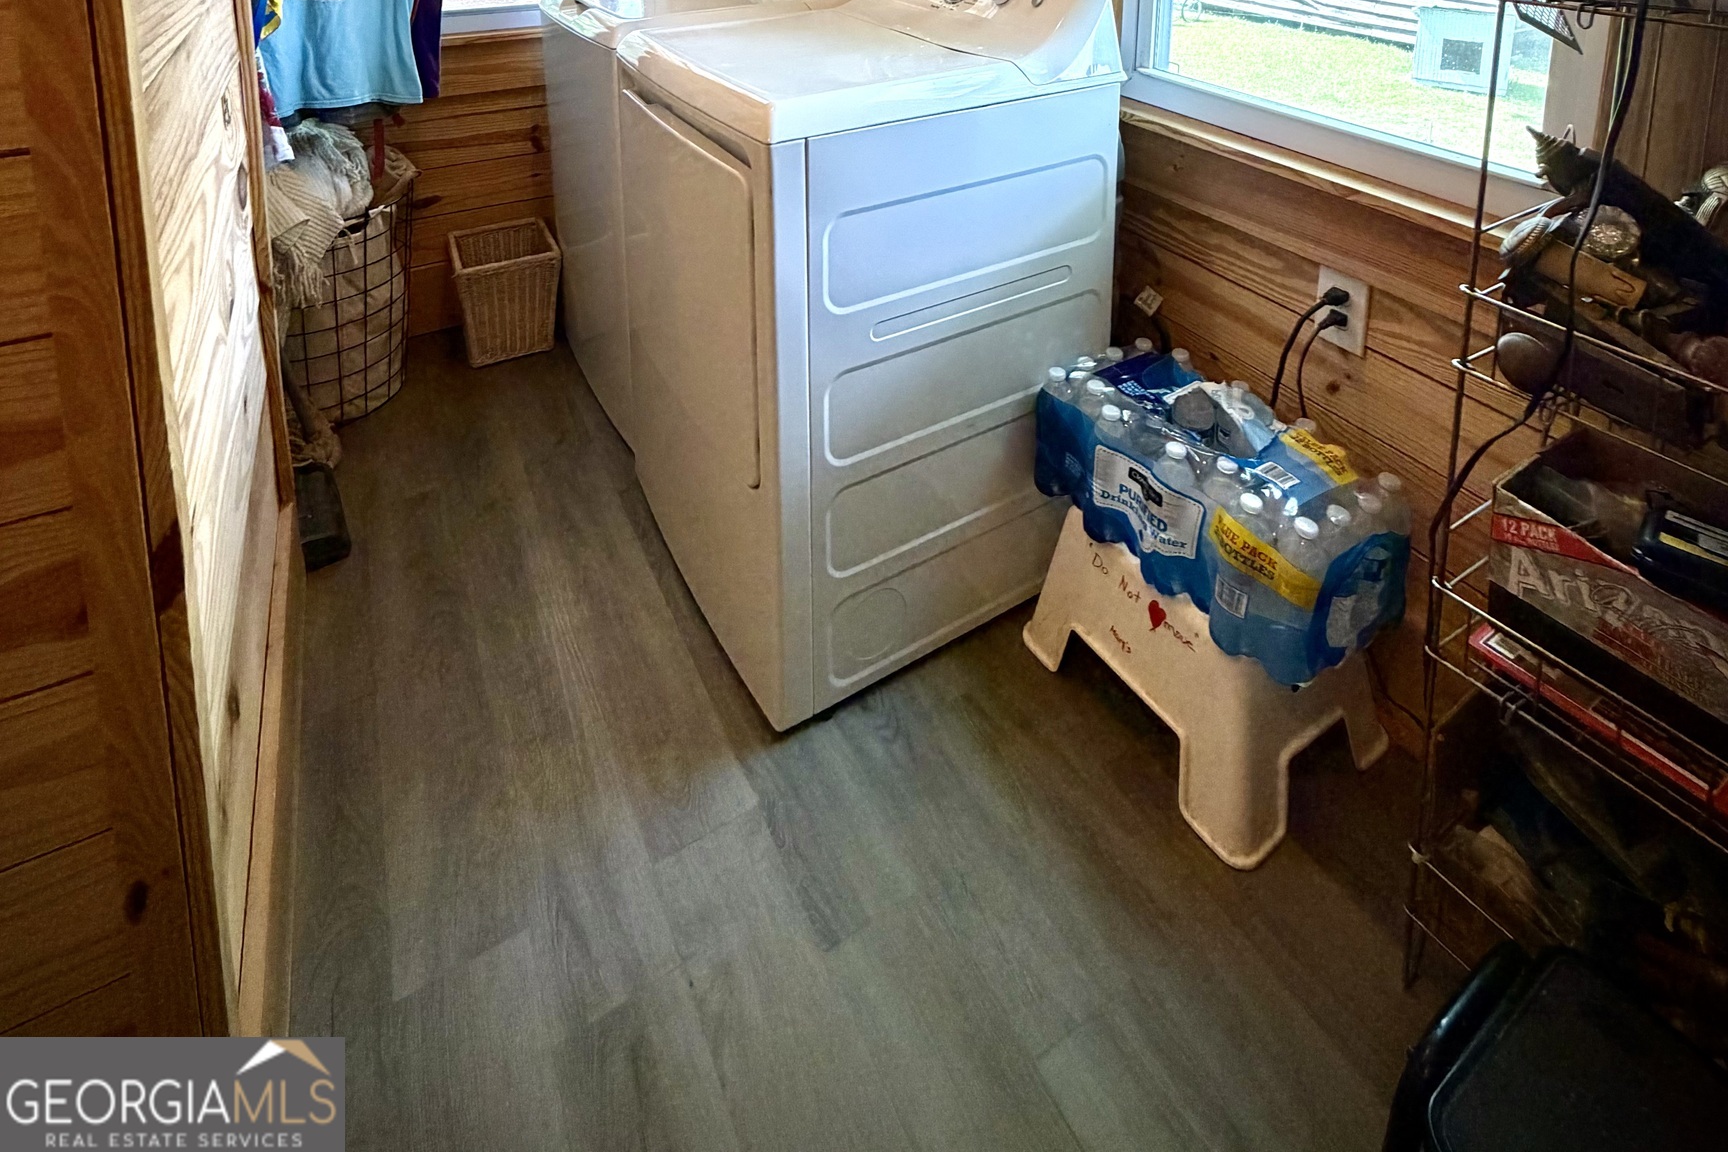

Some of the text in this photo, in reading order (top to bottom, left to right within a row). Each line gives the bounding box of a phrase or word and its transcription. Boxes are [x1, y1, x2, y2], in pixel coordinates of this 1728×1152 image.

[1501, 518, 1517, 534] 12
[1520, 522, 1557, 542] PACK
[1240, 540, 1278, 570] PACK
[1119, 575, 1141, 603] Not
